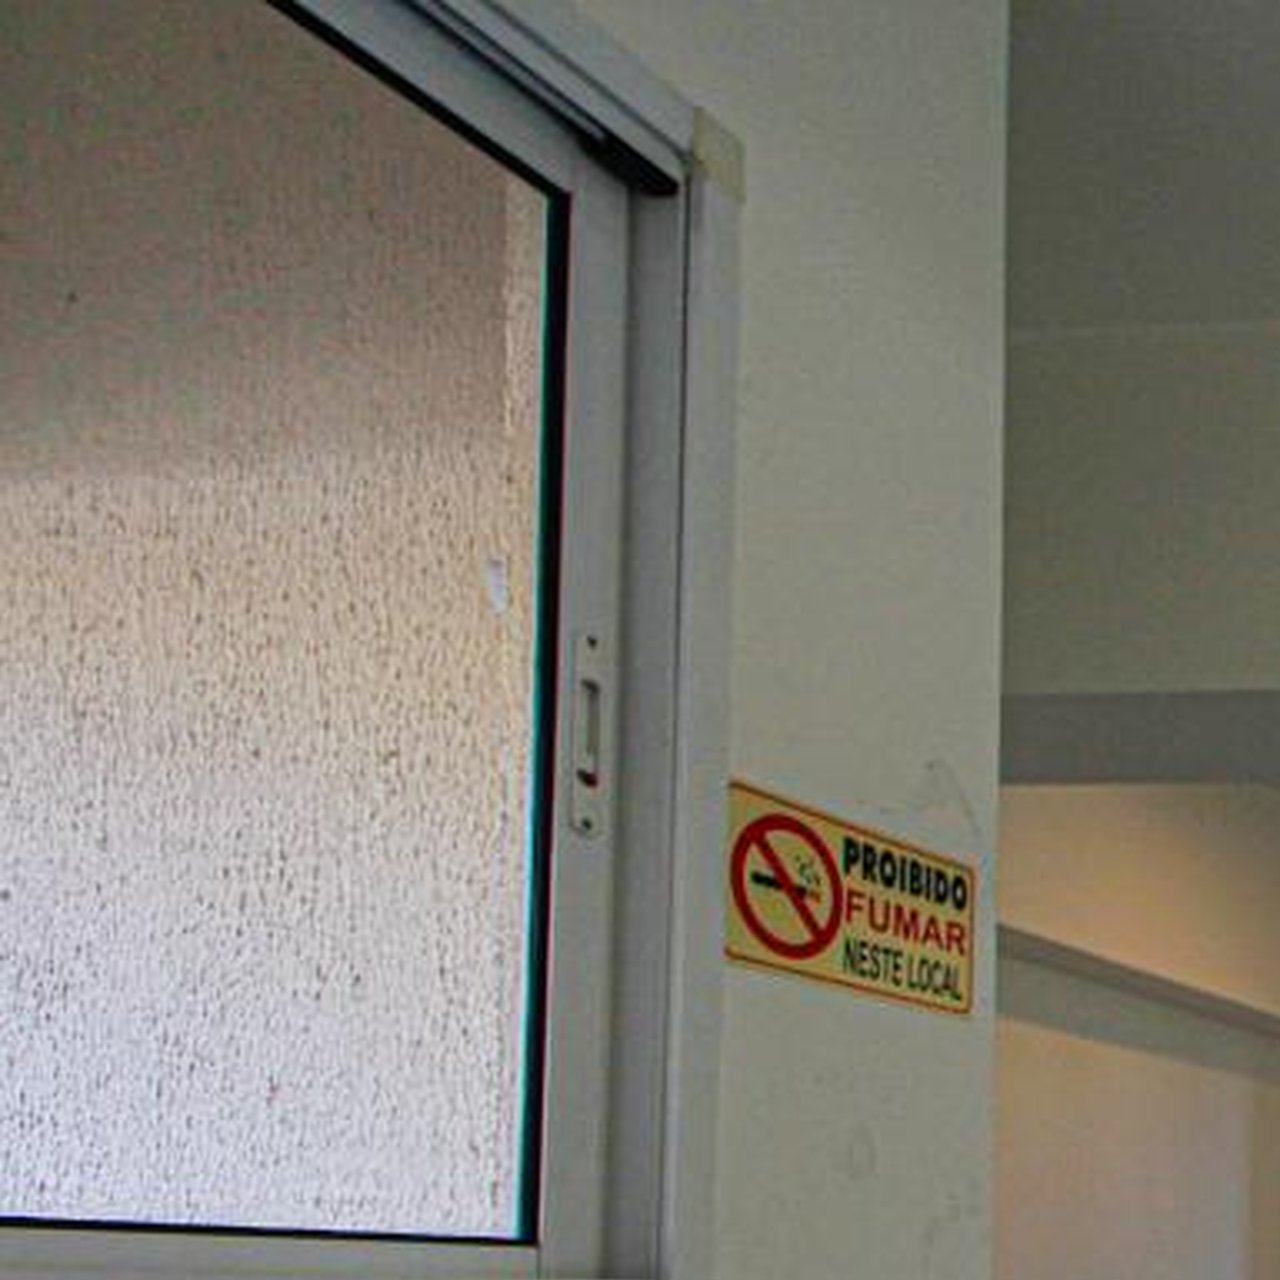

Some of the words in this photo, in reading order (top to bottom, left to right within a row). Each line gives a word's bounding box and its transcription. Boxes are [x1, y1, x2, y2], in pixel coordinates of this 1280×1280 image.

[843, 838, 967, 910] PROIBIDO
[845, 889, 966, 957] FUMAR
[843, 938, 903, 987] NESTE
[907, 954, 962, 1001] LOCAL
